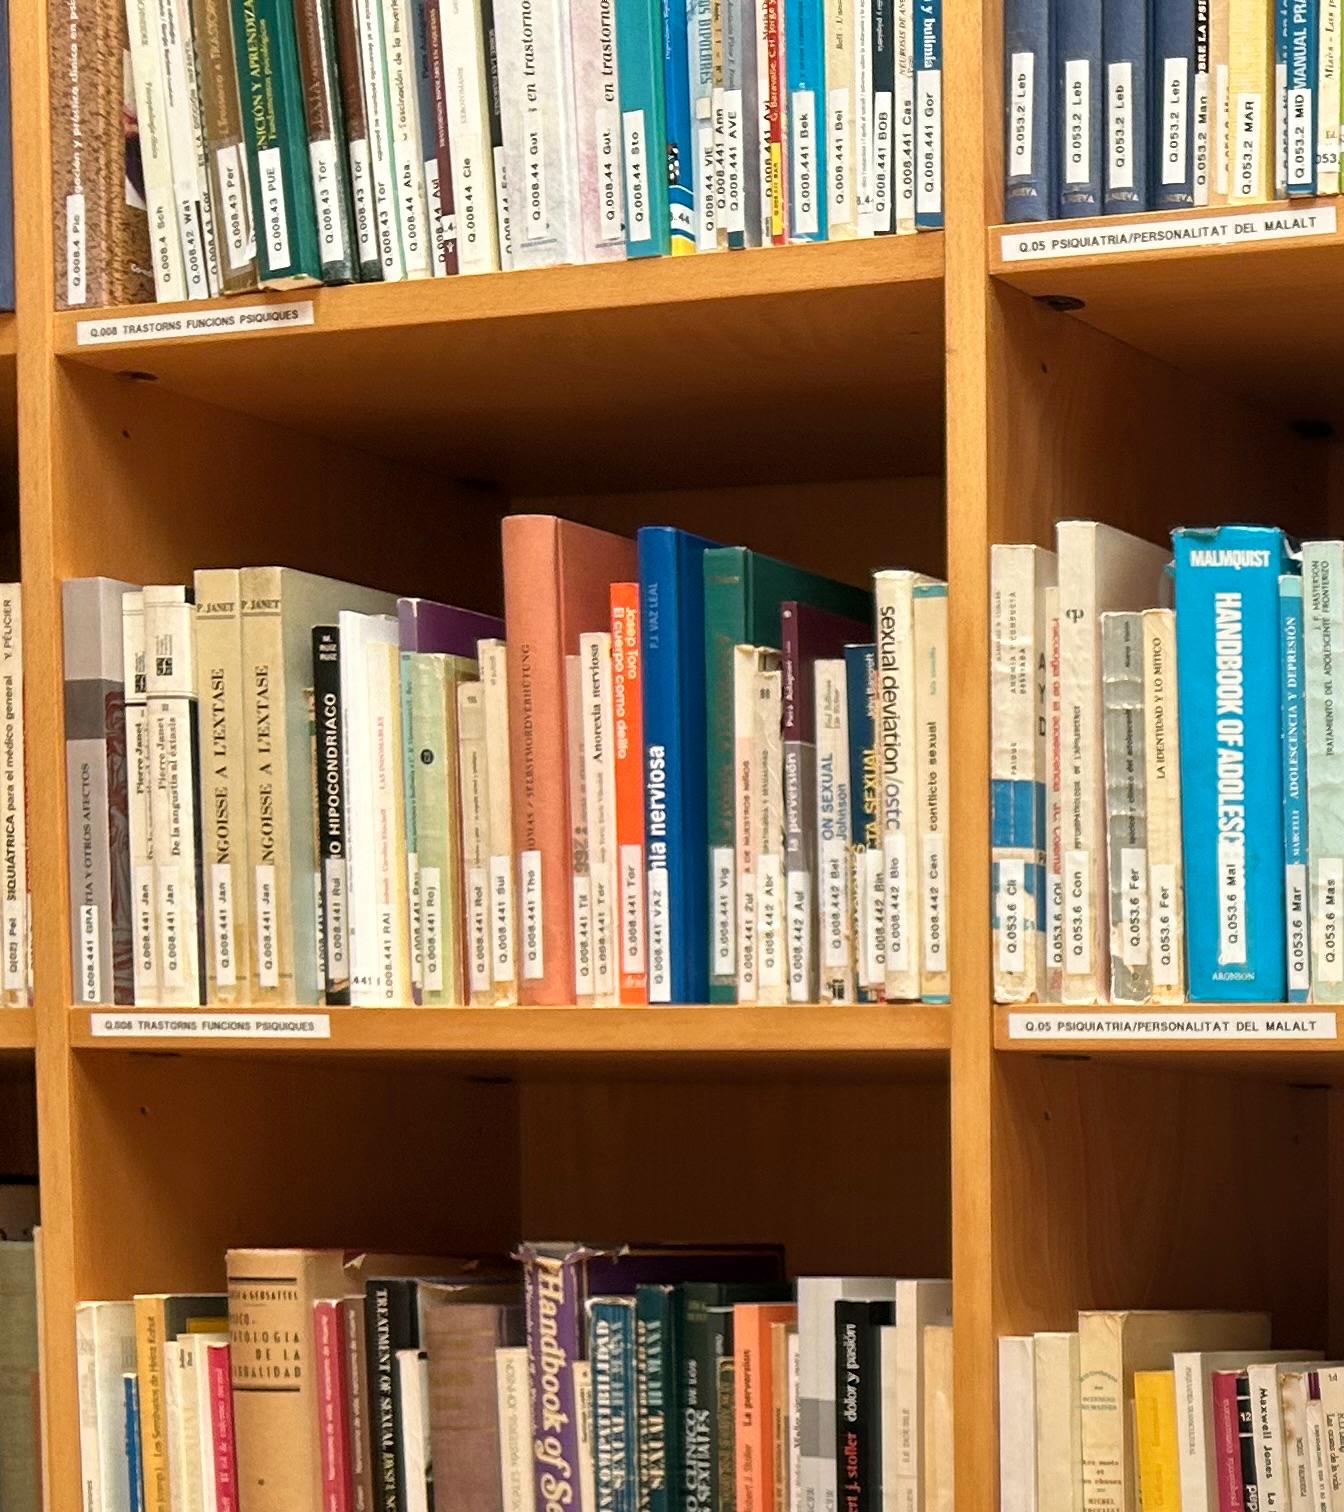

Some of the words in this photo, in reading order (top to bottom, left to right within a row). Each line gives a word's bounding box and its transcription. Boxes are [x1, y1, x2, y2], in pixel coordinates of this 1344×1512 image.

[1293, 30, 1307, 90] MANUAL
[1018, 73, 1026, 99] Leb
[925, 92, 934, 116] Gor
[1016, 104, 1024, 154] Q.053.2
[925, 123, 934, 193] Q.008.441
[1019, 240, 1045, 252] Q.05
[1051, 225, 1228, 249] PSIQUIATRIA/PERSONALITAT
[1235, 222, 1257, 235] DEL
[1265, 216, 1316, 232] MALALT
[123, 320, 182, 334] TRASTORNS
[187, 315, 235, 328] FUNCIONS
[240, 309, 298, 324] PSIQUIQUES
[1190, 551, 1271, 570] MALMQUIST
[880, 605, 896, 673] sexual
[1215, 592, 1242, 712] HANDBOOK
[1216, 718, 1243, 747] OF
[1216, 747, 1244, 845] ADOLESC
[138, 1021, 197, 1032] TRASTORNS
[202, 1021, 251, 1032] FUNCIONS
[256, 1021, 314, 1032] PSIQUIQUES
[1026, 1021, 1051, 1033] Q.05
[1057, 1020, 1229, 1033] PSIQUIATRIA/PERSONALITAT
[1236, 1021, 1257, 1032] DEL
[1265, 1021, 1316, 1032] MALALT
